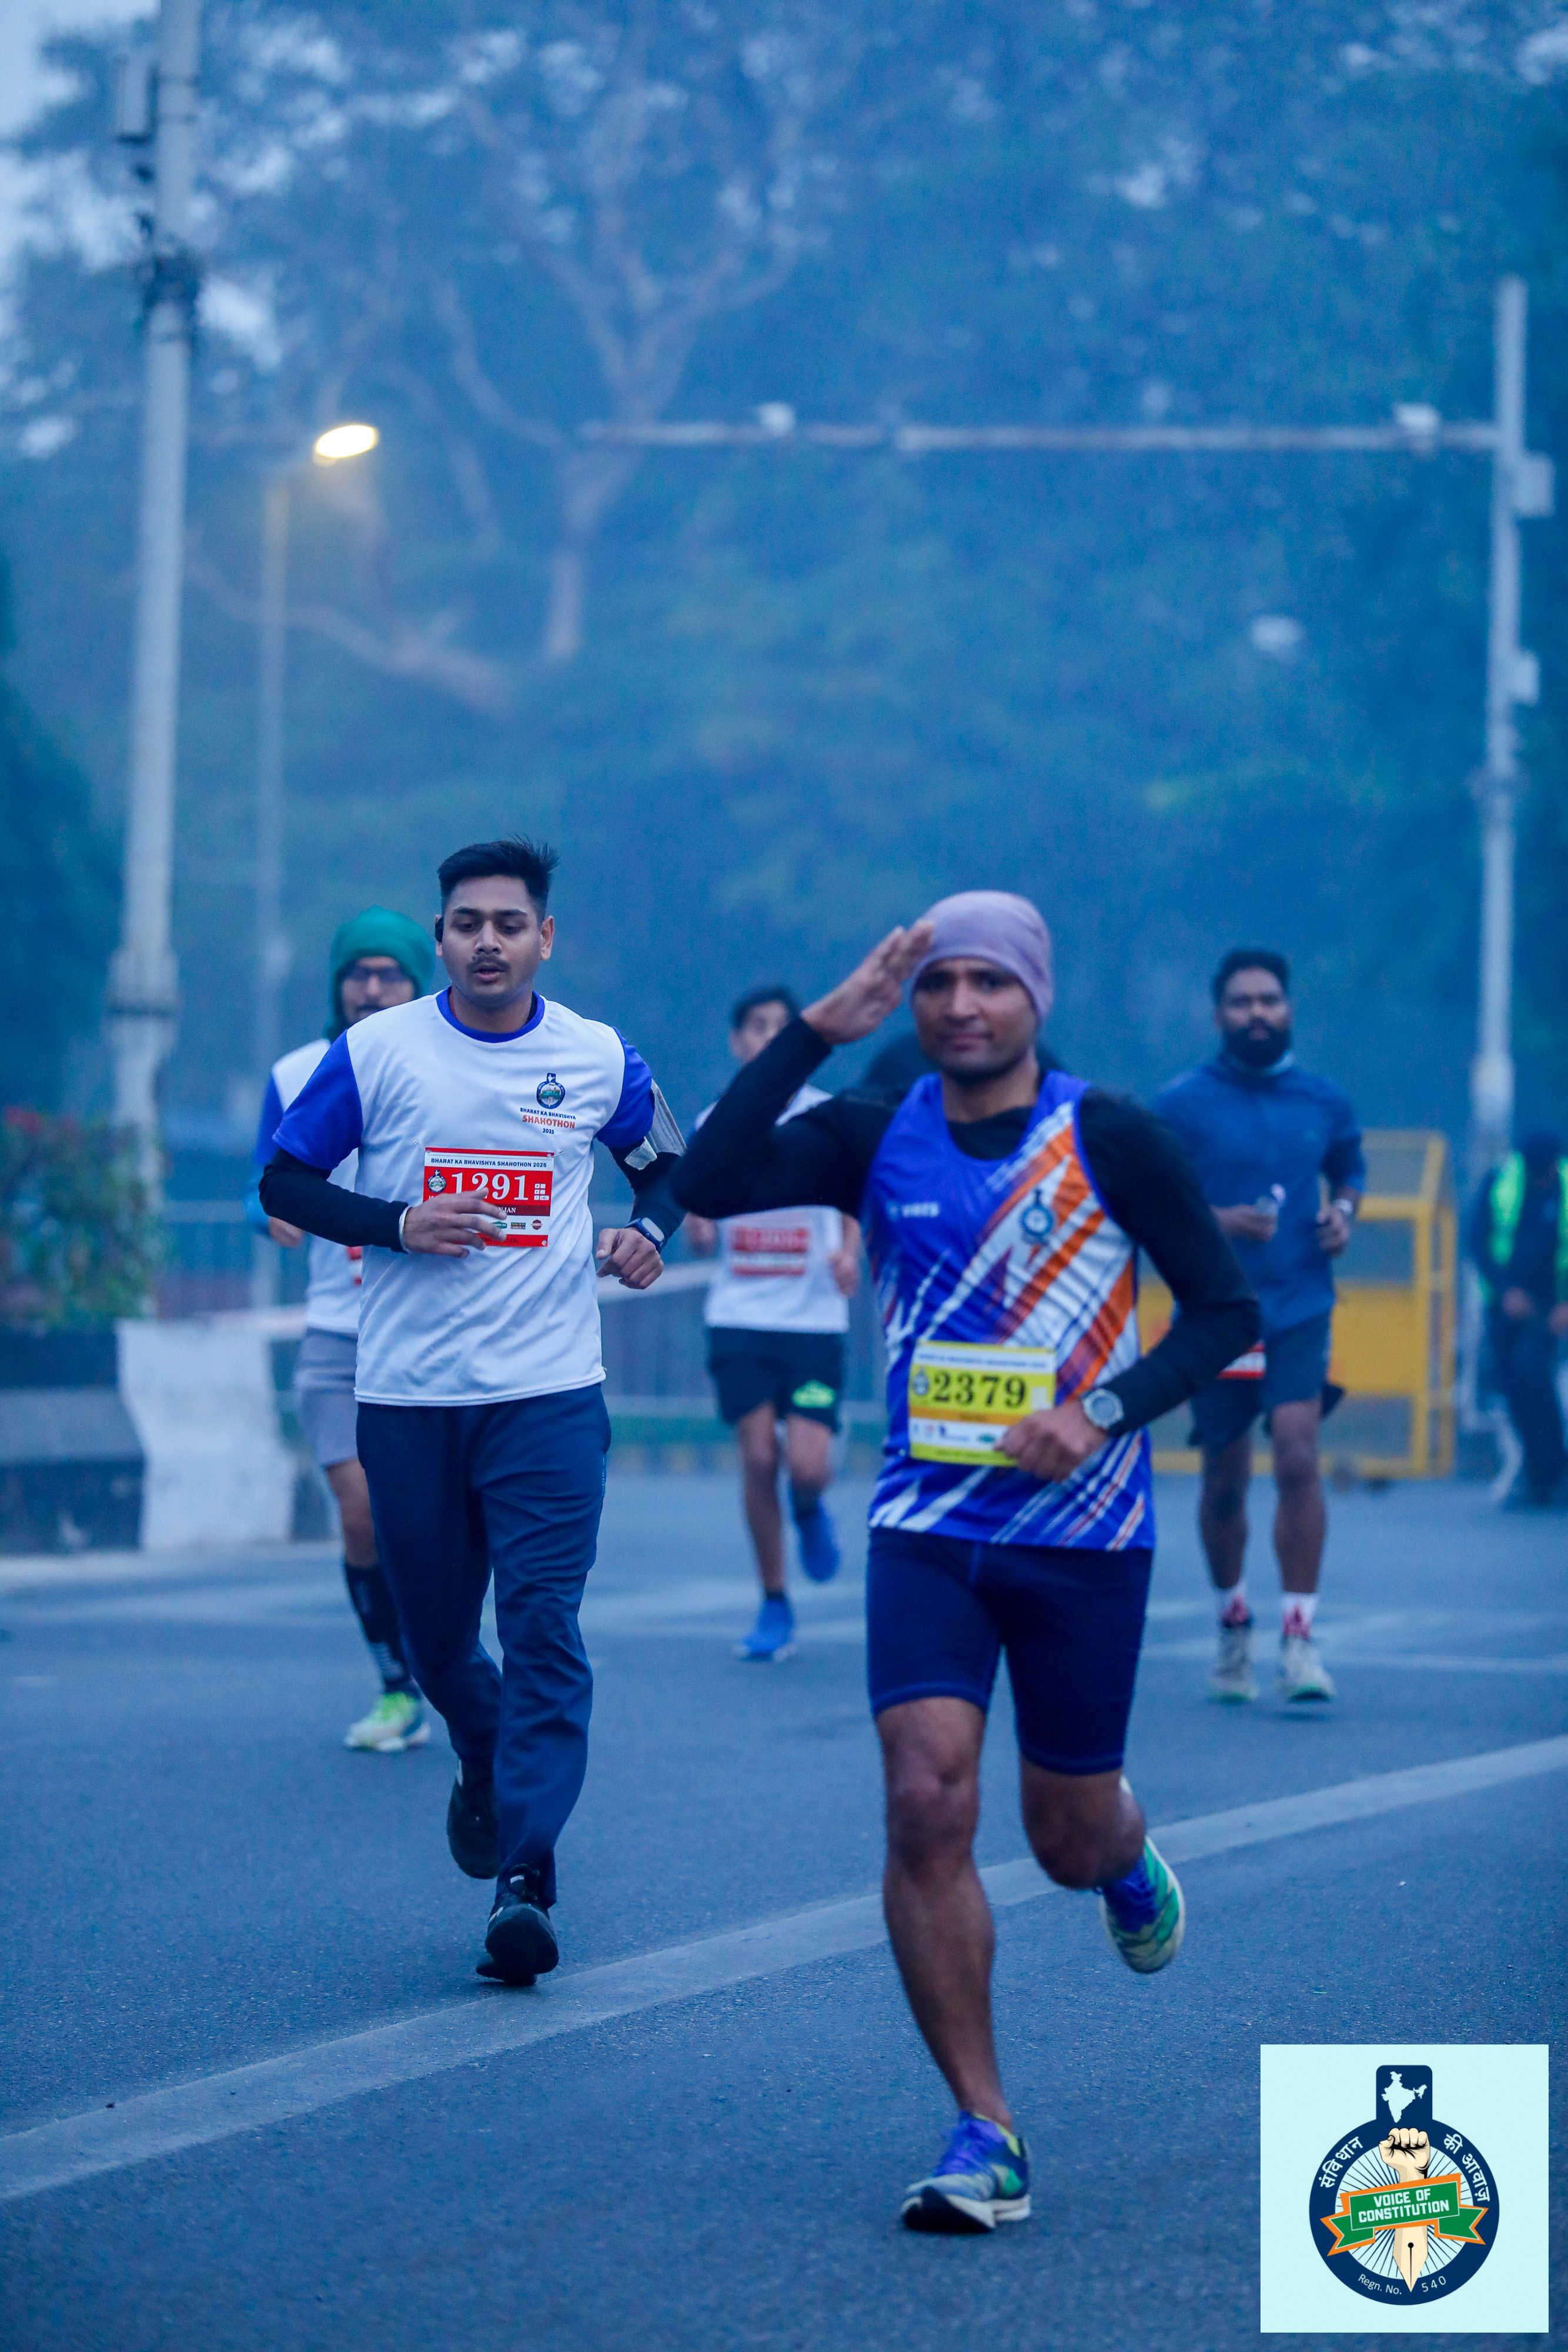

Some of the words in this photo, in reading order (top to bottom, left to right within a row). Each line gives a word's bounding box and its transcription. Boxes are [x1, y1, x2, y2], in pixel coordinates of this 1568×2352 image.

[520, 1107, 540, 1115] BHARAT
[549, 1111, 576, 1120] BHAVISHYA
[522, 1115, 576, 1129] SHAHOTHON
[452, 1172, 529, 1201] 1291
[934, 1371, 1027, 1409] 2379
